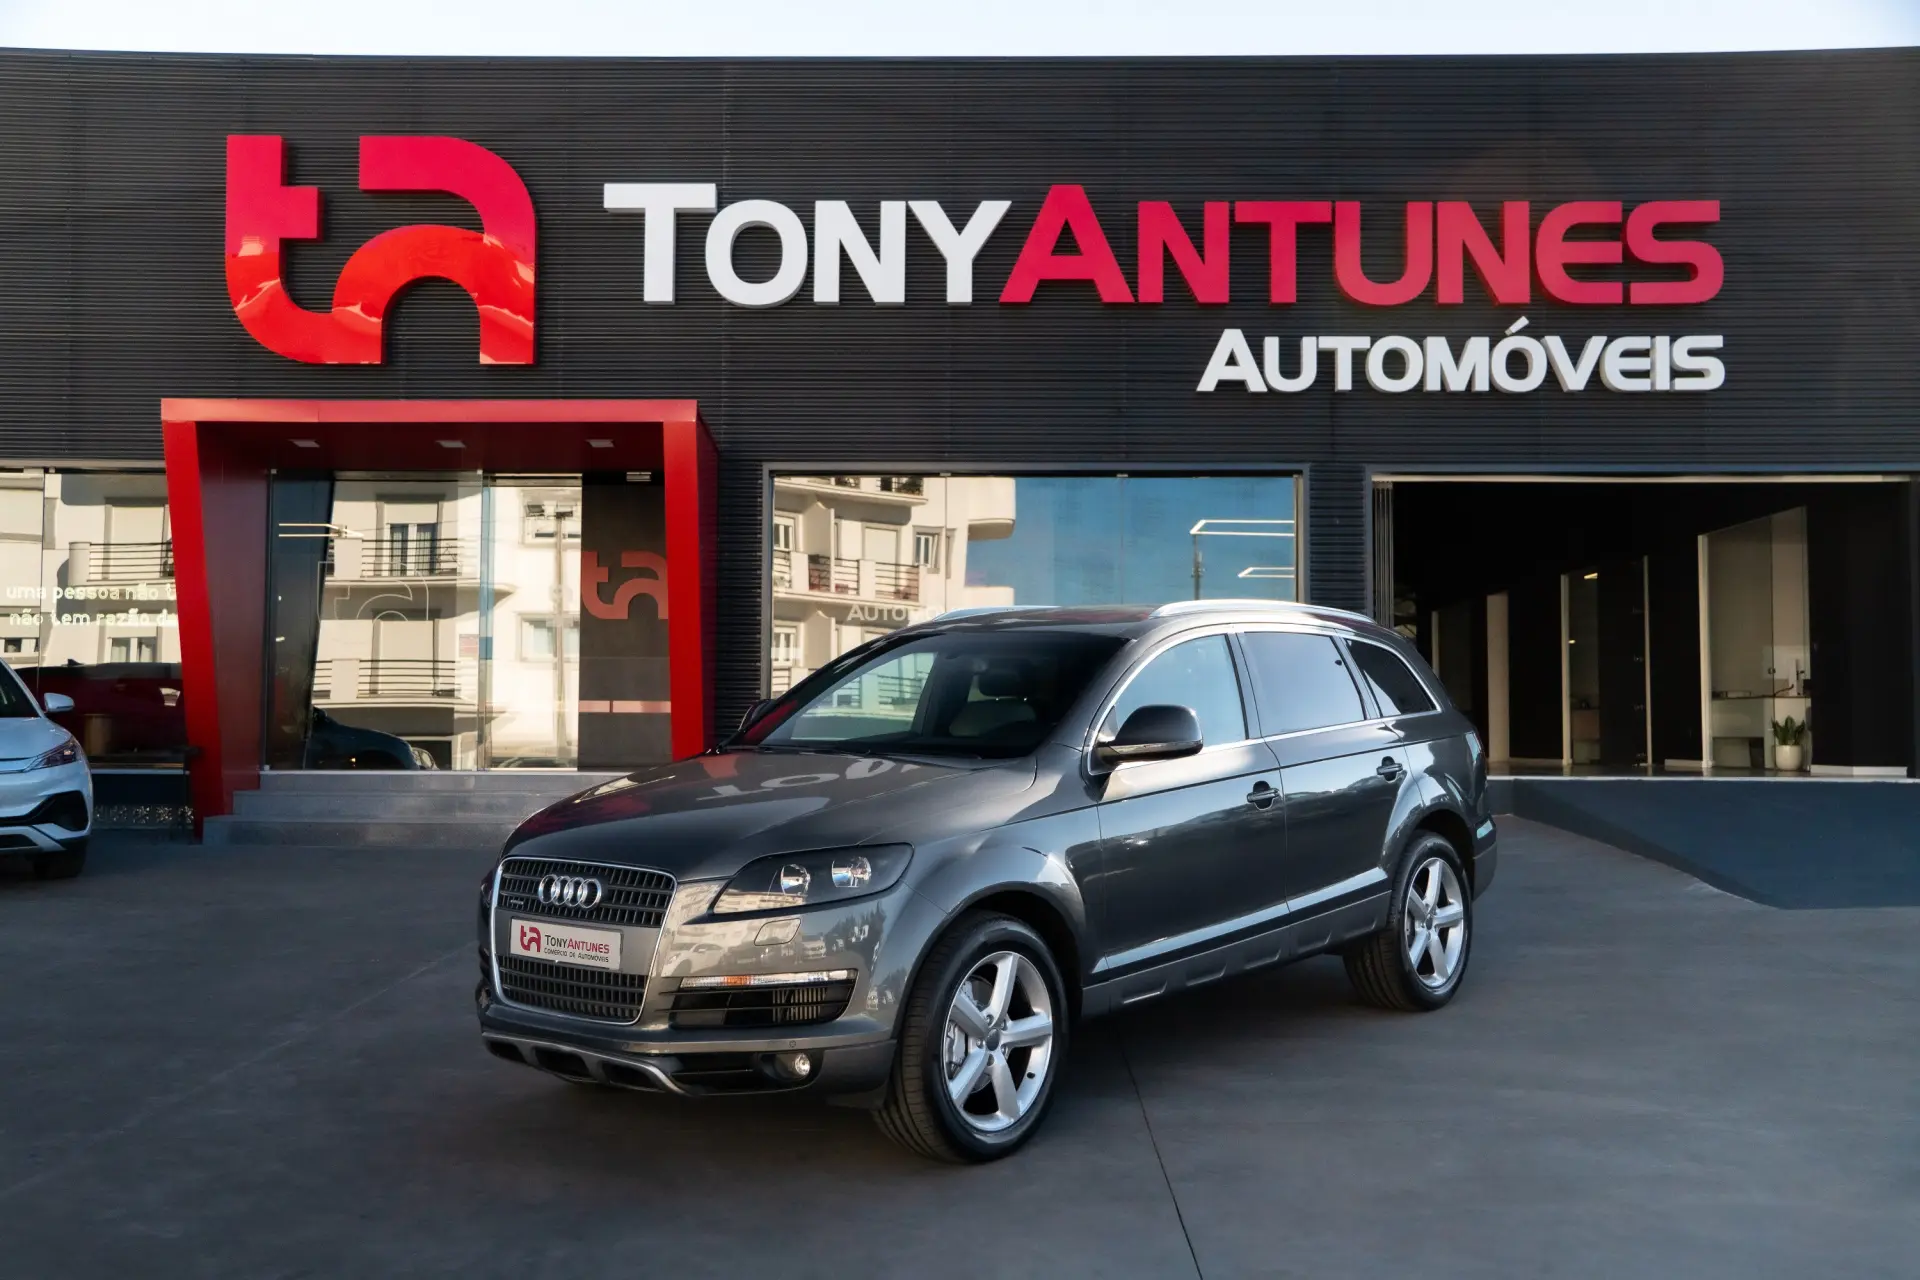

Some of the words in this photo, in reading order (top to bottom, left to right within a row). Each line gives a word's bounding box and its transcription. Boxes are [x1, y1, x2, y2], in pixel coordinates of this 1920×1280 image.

[1196, 315, 1726, 395] AUTOMÓVEIS
[6, 585, 46, 599] uma
[52, 586, 120, 602] pessoa
[125, 582, 159, 600] não
[9, 608, 43, 626] não
[51, 608, 91, 626] tem
[96, 608, 150, 627] razão
